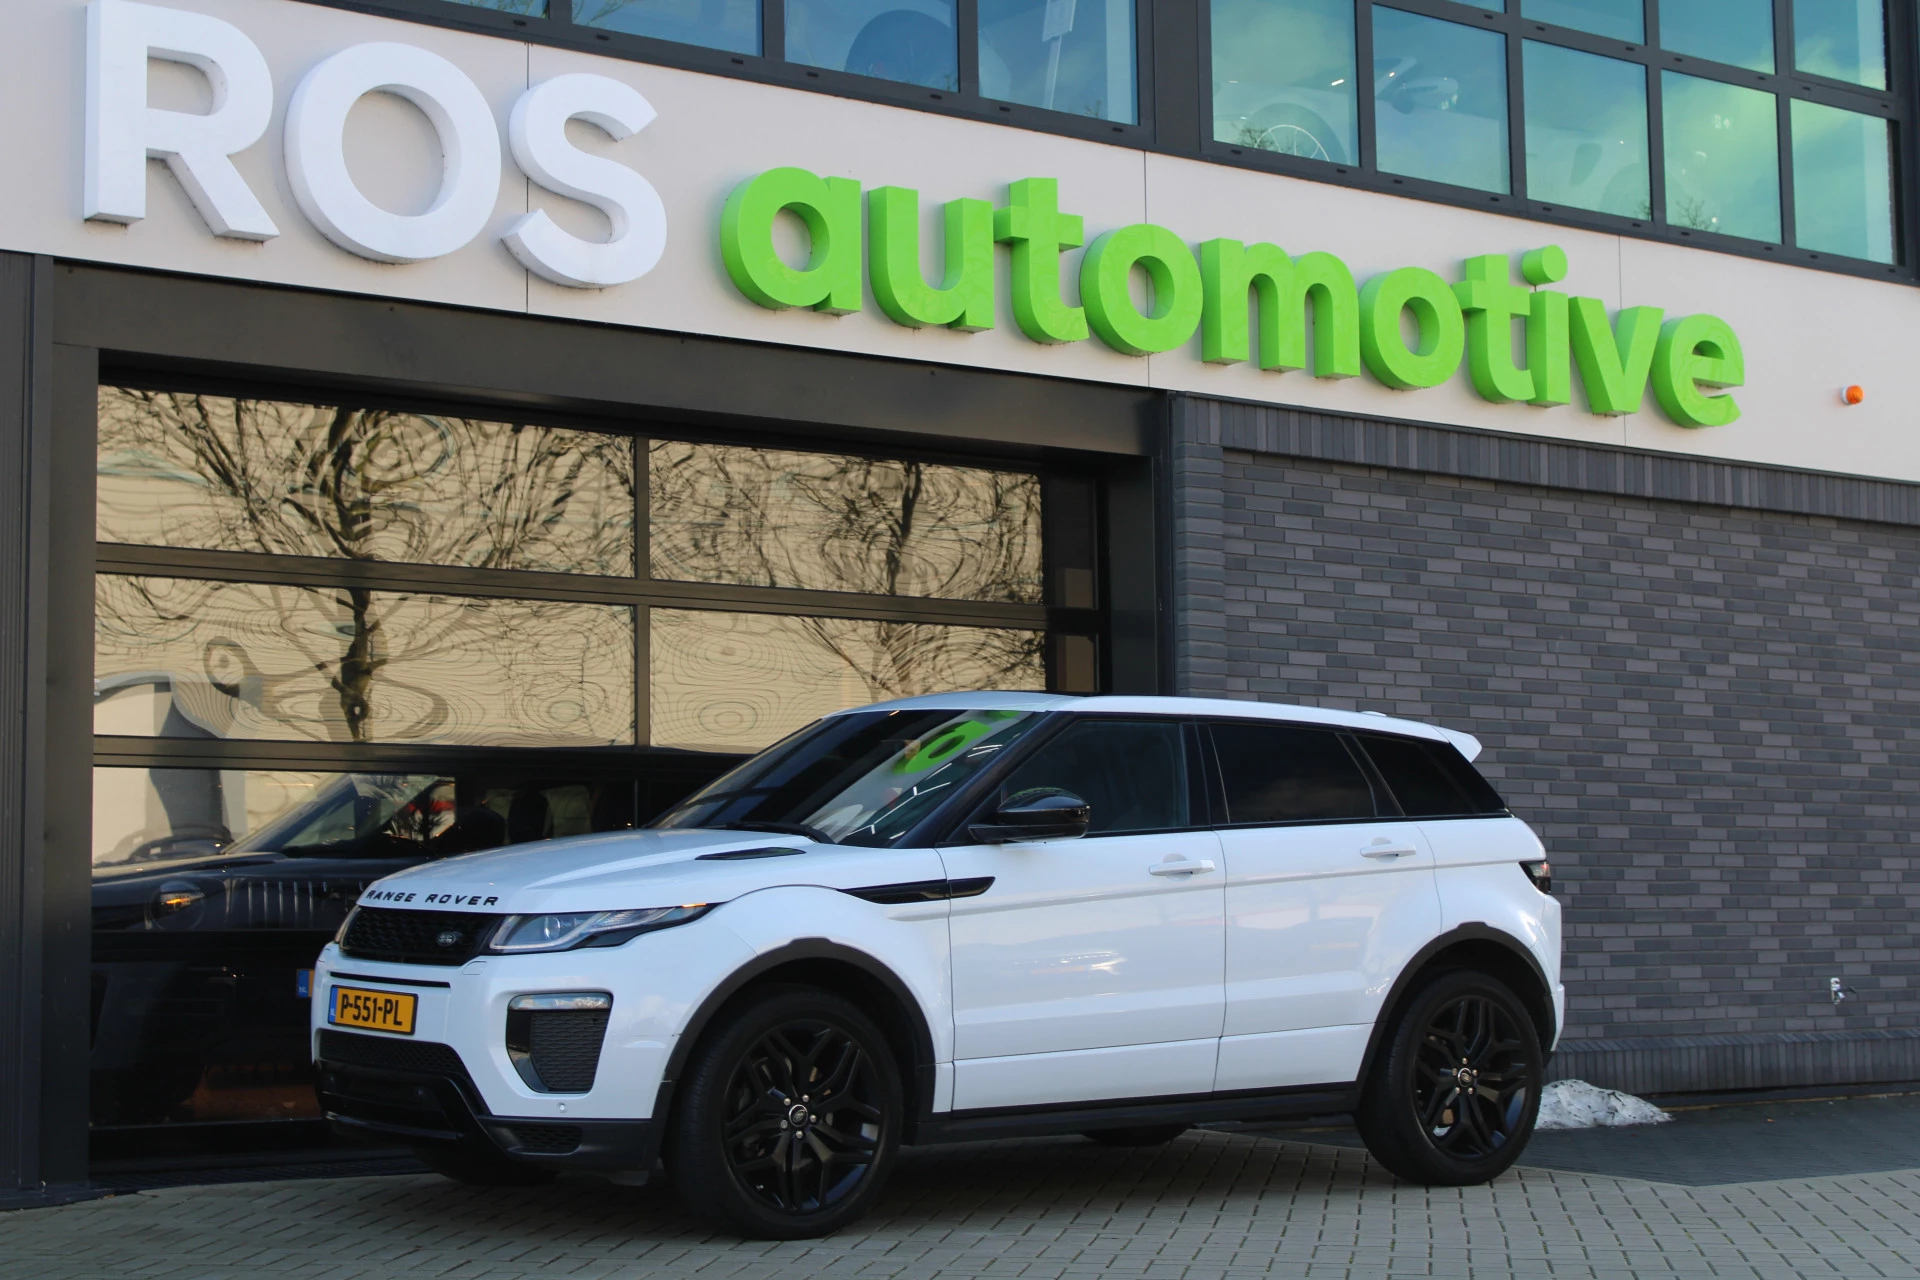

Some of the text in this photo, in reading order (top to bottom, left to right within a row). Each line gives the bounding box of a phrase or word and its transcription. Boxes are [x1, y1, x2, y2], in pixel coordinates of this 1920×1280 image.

[83, 0, 1746, 429] ROS automotive
[365, 889, 499, 906] RANGE ROVER
[340, 993, 403, 1027] P-551-PL
